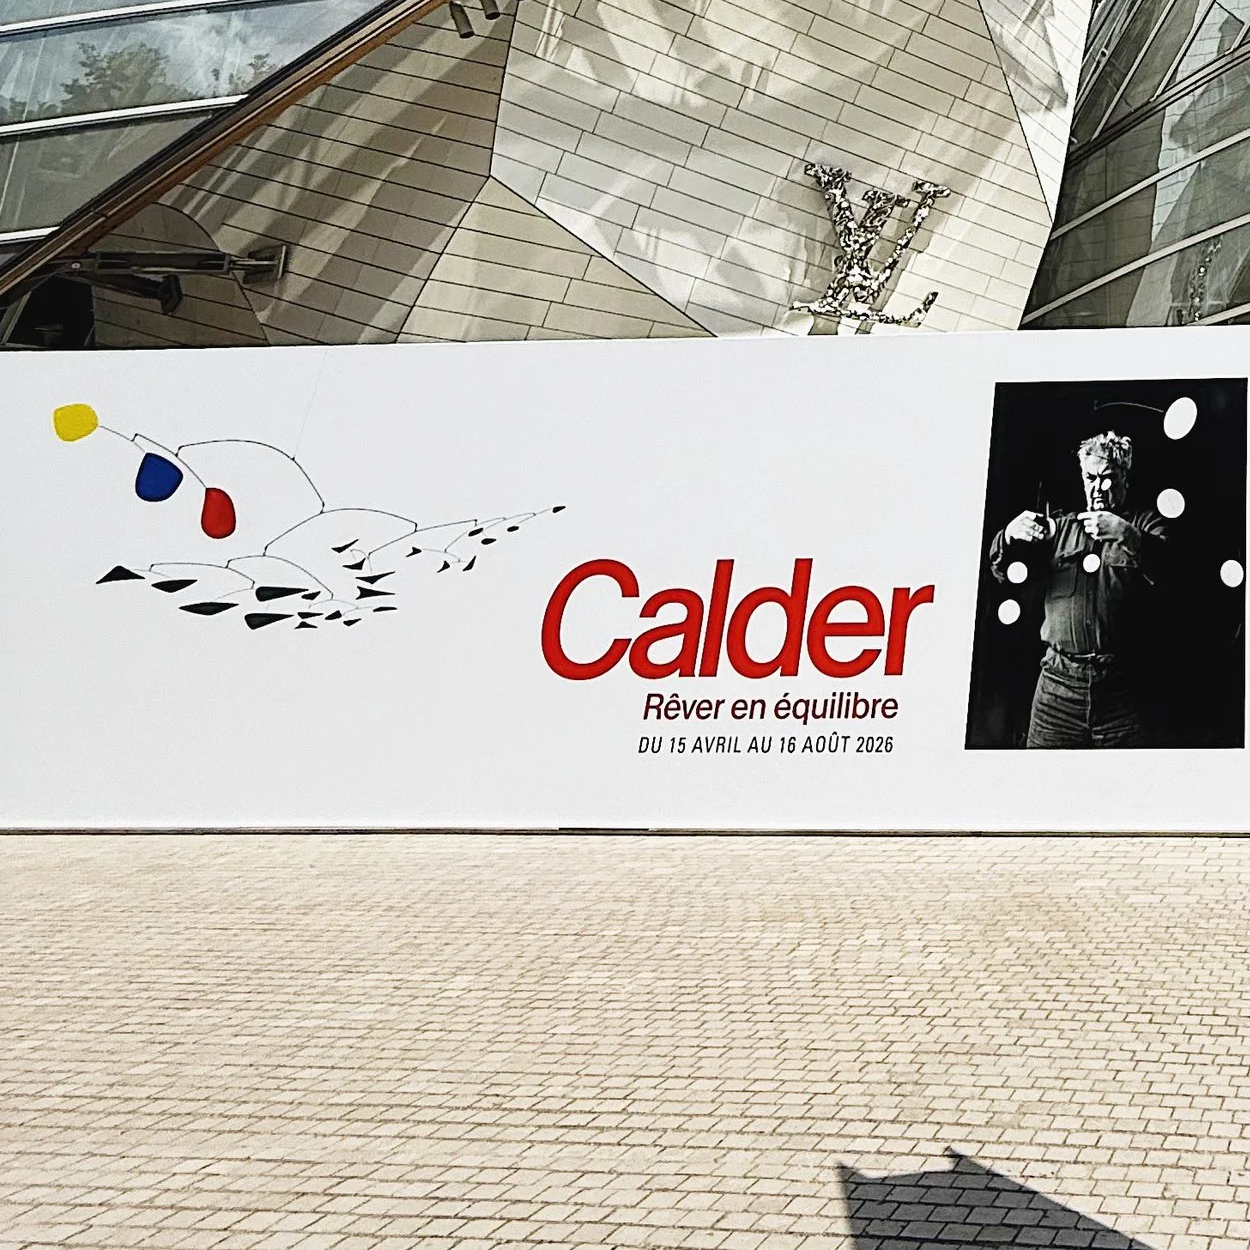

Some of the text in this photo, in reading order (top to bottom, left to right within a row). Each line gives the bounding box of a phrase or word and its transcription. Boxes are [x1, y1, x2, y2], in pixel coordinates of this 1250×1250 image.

[541, 558, 935, 681] Calder
[643, 692, 899, 725] Rêver en équilibre
[638, 731, 894, 754] DU 15 AVRIL AU 16 AOÛT 2026
